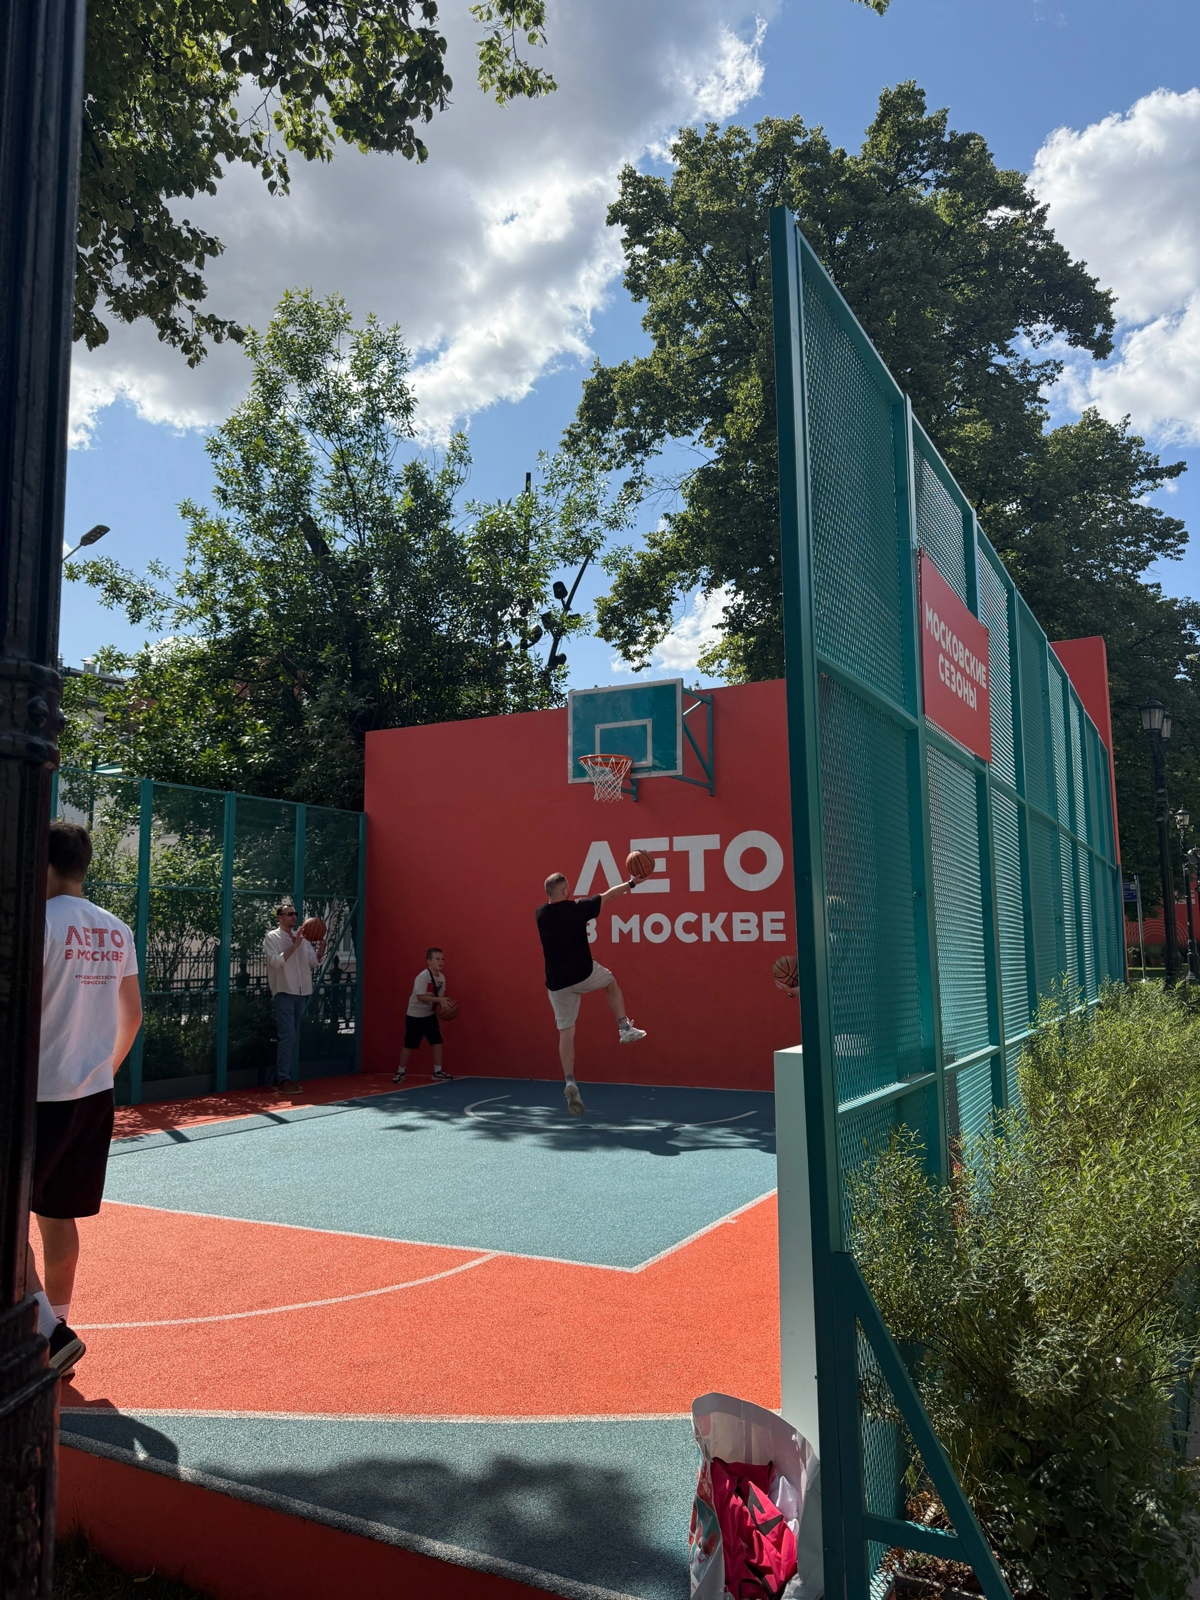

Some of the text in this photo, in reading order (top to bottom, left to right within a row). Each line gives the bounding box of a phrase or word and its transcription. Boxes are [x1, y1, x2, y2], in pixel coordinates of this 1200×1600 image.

[925, 601, 987, 690] МОСКОВСКИЕ
[938, 653, 977, 711] СЕЗОНЫ
[573, 830, 784, 896] ЛЕТО
[65, 925, 124, 948] ЛЕТО
[611, 911, 787, 943] МОСКВЕ
[64, 949, 74, 960] В
